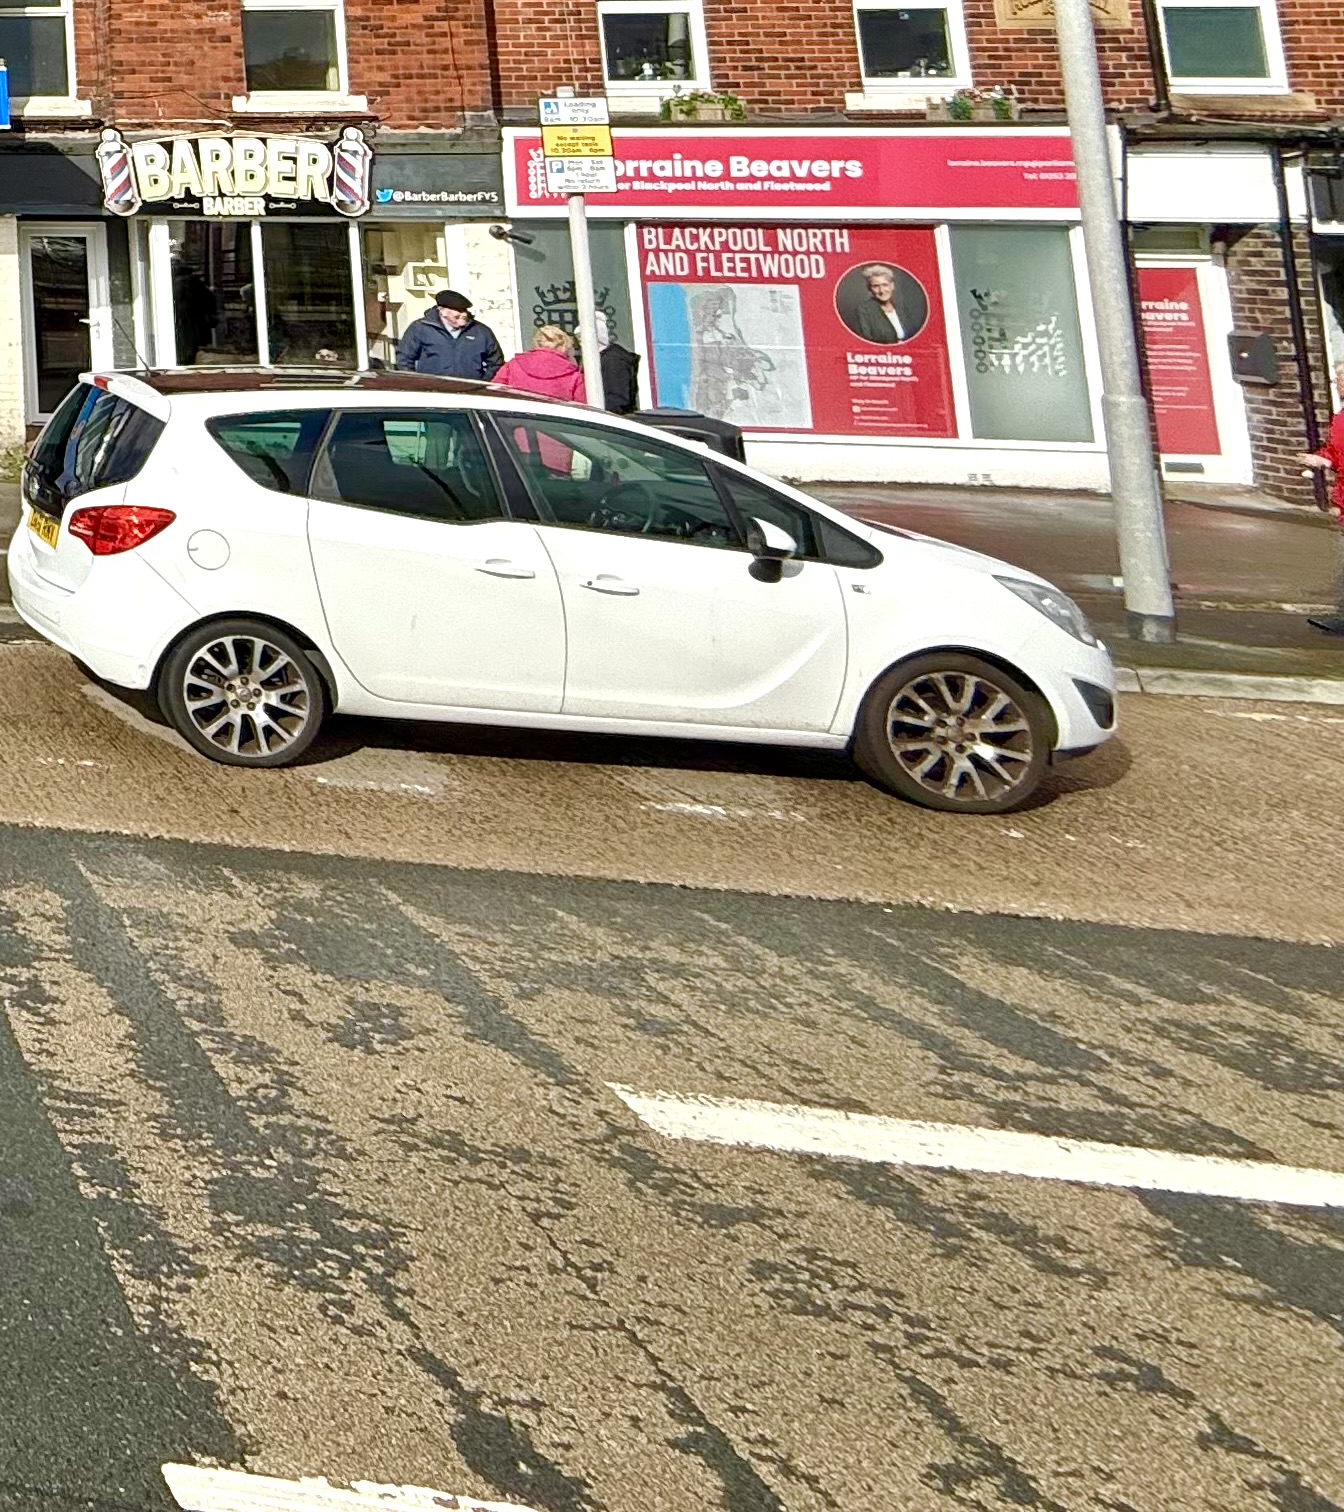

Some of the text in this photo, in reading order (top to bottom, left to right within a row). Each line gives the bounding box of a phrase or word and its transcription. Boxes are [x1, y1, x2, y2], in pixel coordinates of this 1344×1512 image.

[132, 137, 334, 202] BARBER
[614, 153, 863, 178] orraine Beavers
[632, 180, 695, 193] Blackpool
[697, 180, 734, 191] North
[736, 181, 762, 191] and
[203, 197, 266, 216] BARBER
[643, 227, 850, 253] BLACKPOOL NORTH
[645, 252, 826, 279] AND FLEETWOOD
[1141, 298, 1189, 310] rraine
[846, 351, 912, 364] Lorraine
[847, 364, 913, 376] Beavers
